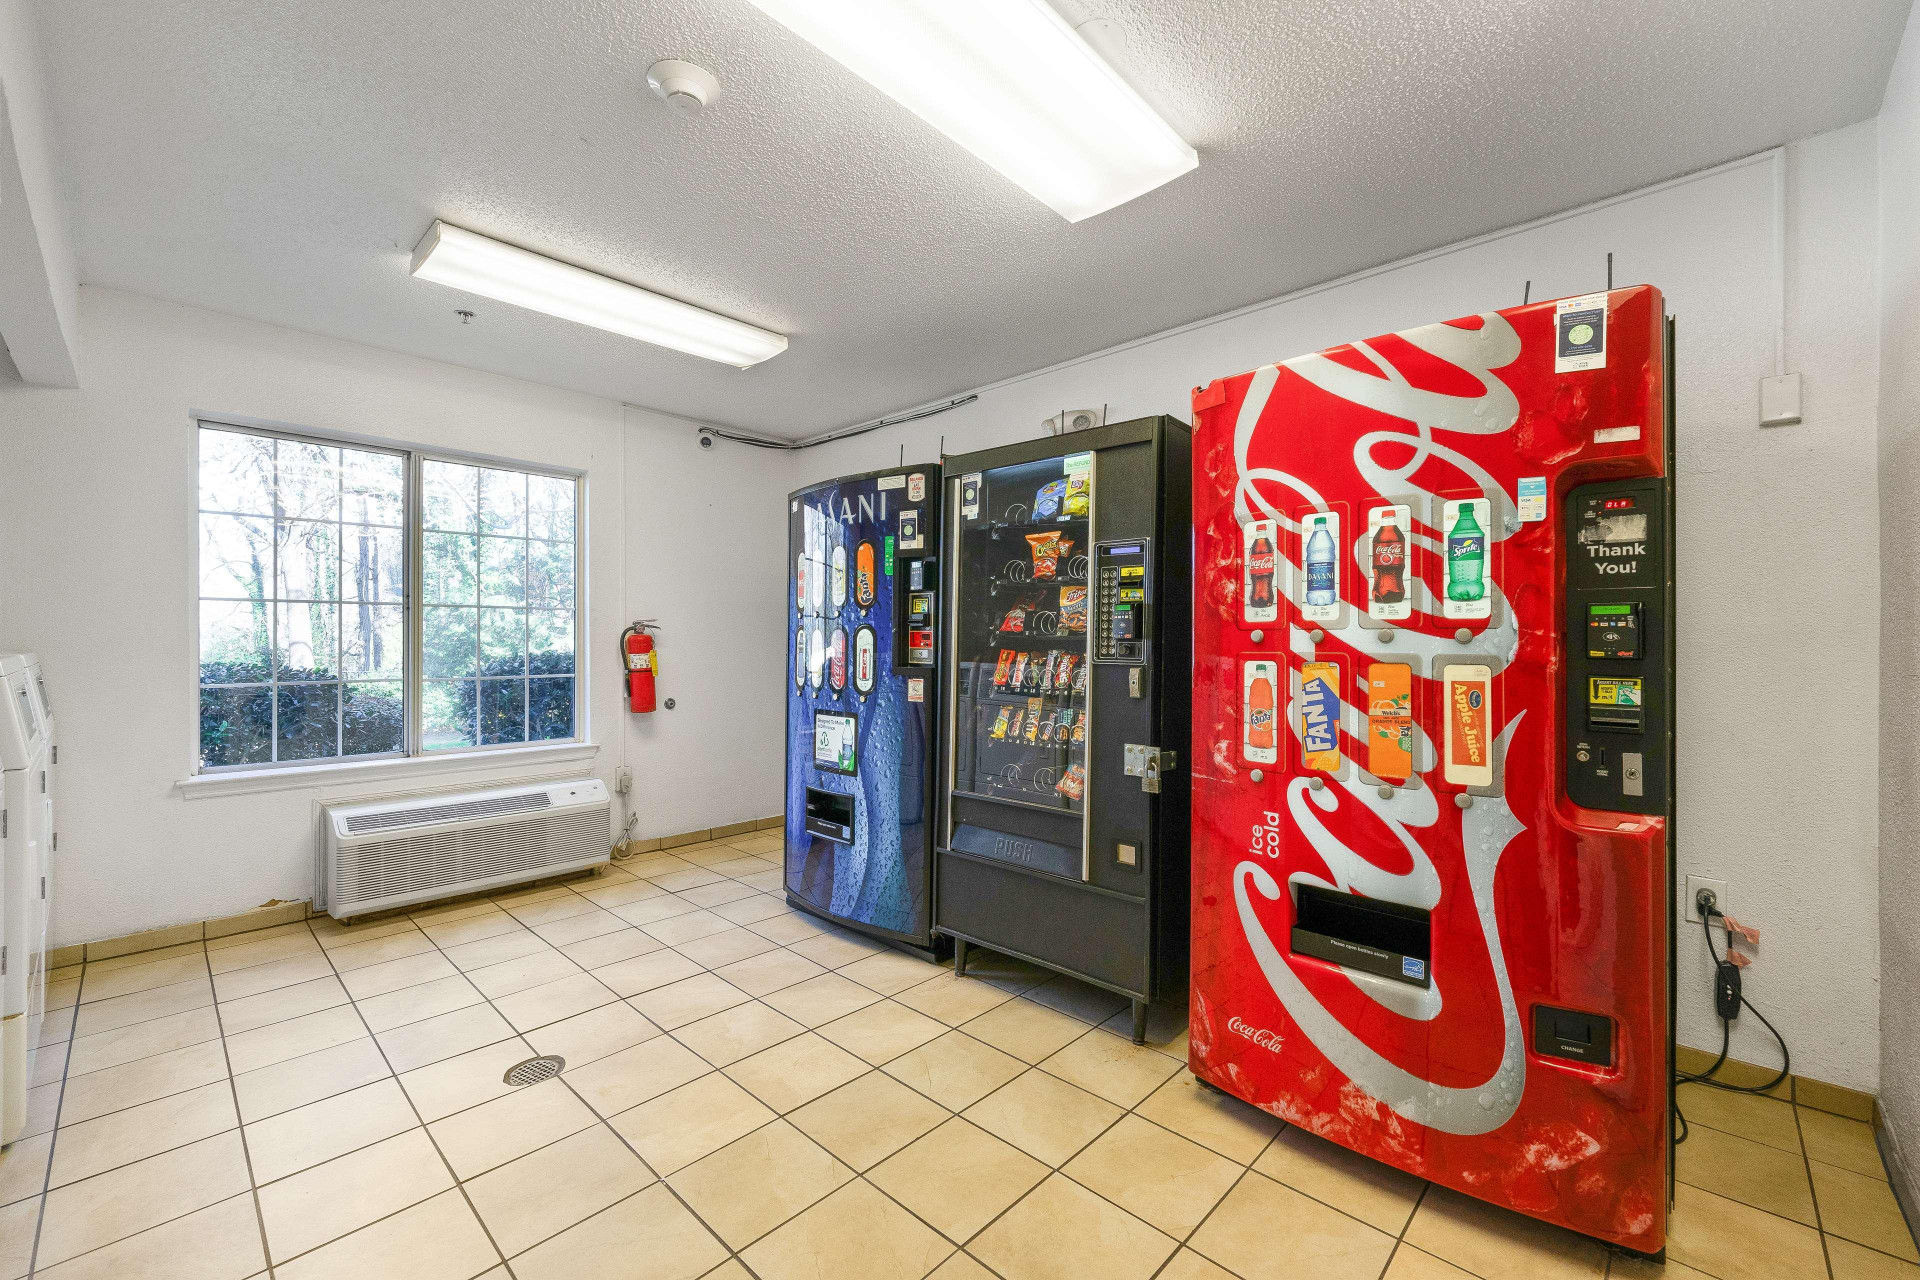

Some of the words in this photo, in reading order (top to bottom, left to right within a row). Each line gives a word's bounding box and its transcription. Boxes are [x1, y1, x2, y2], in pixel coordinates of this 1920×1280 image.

[1376, 544, 1402, 554] Coca-Cola
[1453, 543, 1479, 557] Sprite
[1586, 543, 1646, 557] Thank
[1249, 556, 1274, 570] Coca-Cola
[1594, 561, 1637, 574] You!
[1308, 572, 1334, 581] DASANI
[1250, 712, 1272, 725] Fanta
[1302, 679, 1332, 752] FANTA
[1454, 683, 1474, 724] Apple
[1464, 726, 1480, 763] Juice
[1249, 825, 1263, 855] ice
[1264, 811, 1280, 858] cold
[994, 837, 1034, 862] PUSH
[1330, 939, 1346, 949] Please
[1345, 943, 1358, 952] open
[1357, 946, 1374, 955] bottles
[1373, 950, 1389, 960] slowly
[1228, 1016, 1285, 1054] Coca-Cola
[1561, 1045, 1584, 1054] CHANGE
